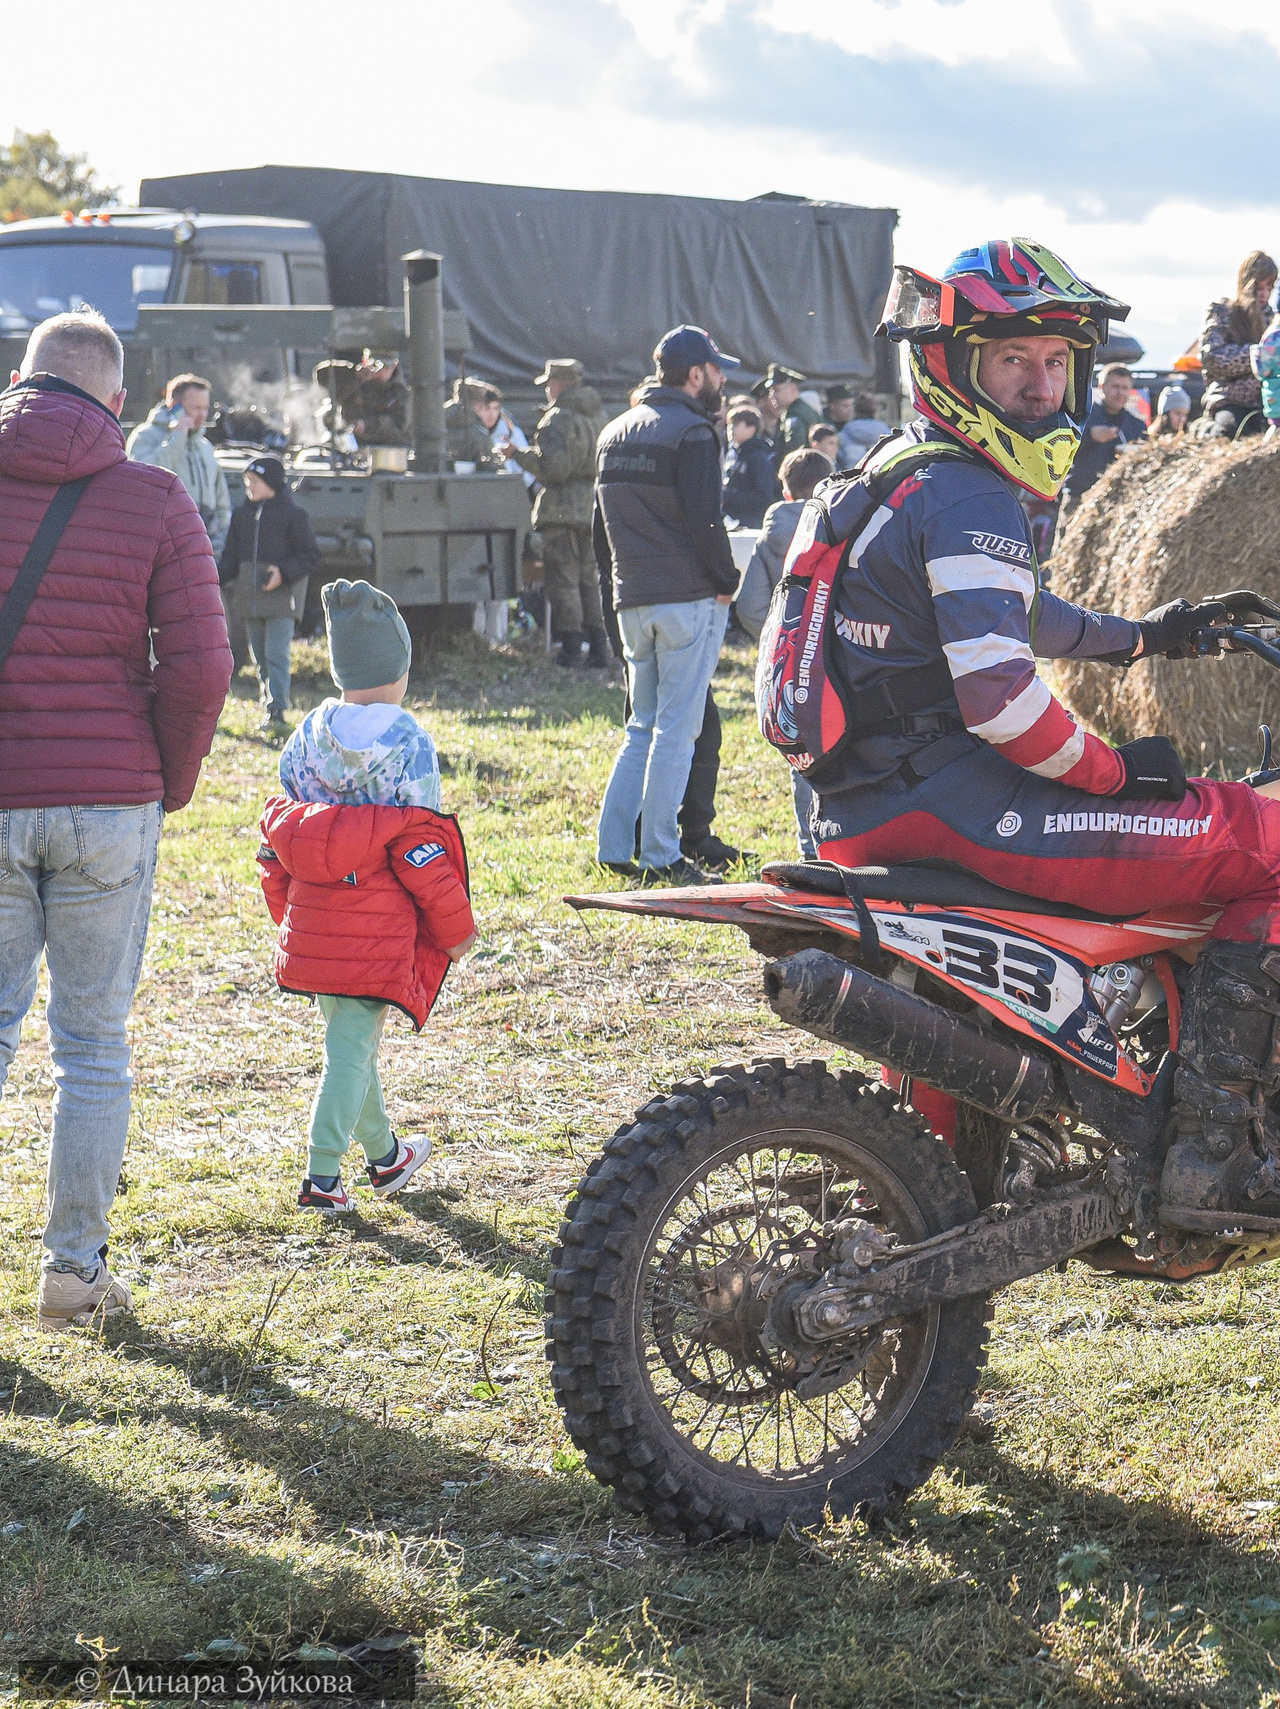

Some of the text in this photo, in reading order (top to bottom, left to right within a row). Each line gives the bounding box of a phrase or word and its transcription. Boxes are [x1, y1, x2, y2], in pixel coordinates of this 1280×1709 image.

[798, 579, 831, 688] ENDUROGORKIY
[1043, 811, 1213, 838] ENDUROGORKIY
[942, 929, 1057, 1013] 33
[1088, 1035, 1115, 1052] UFO
